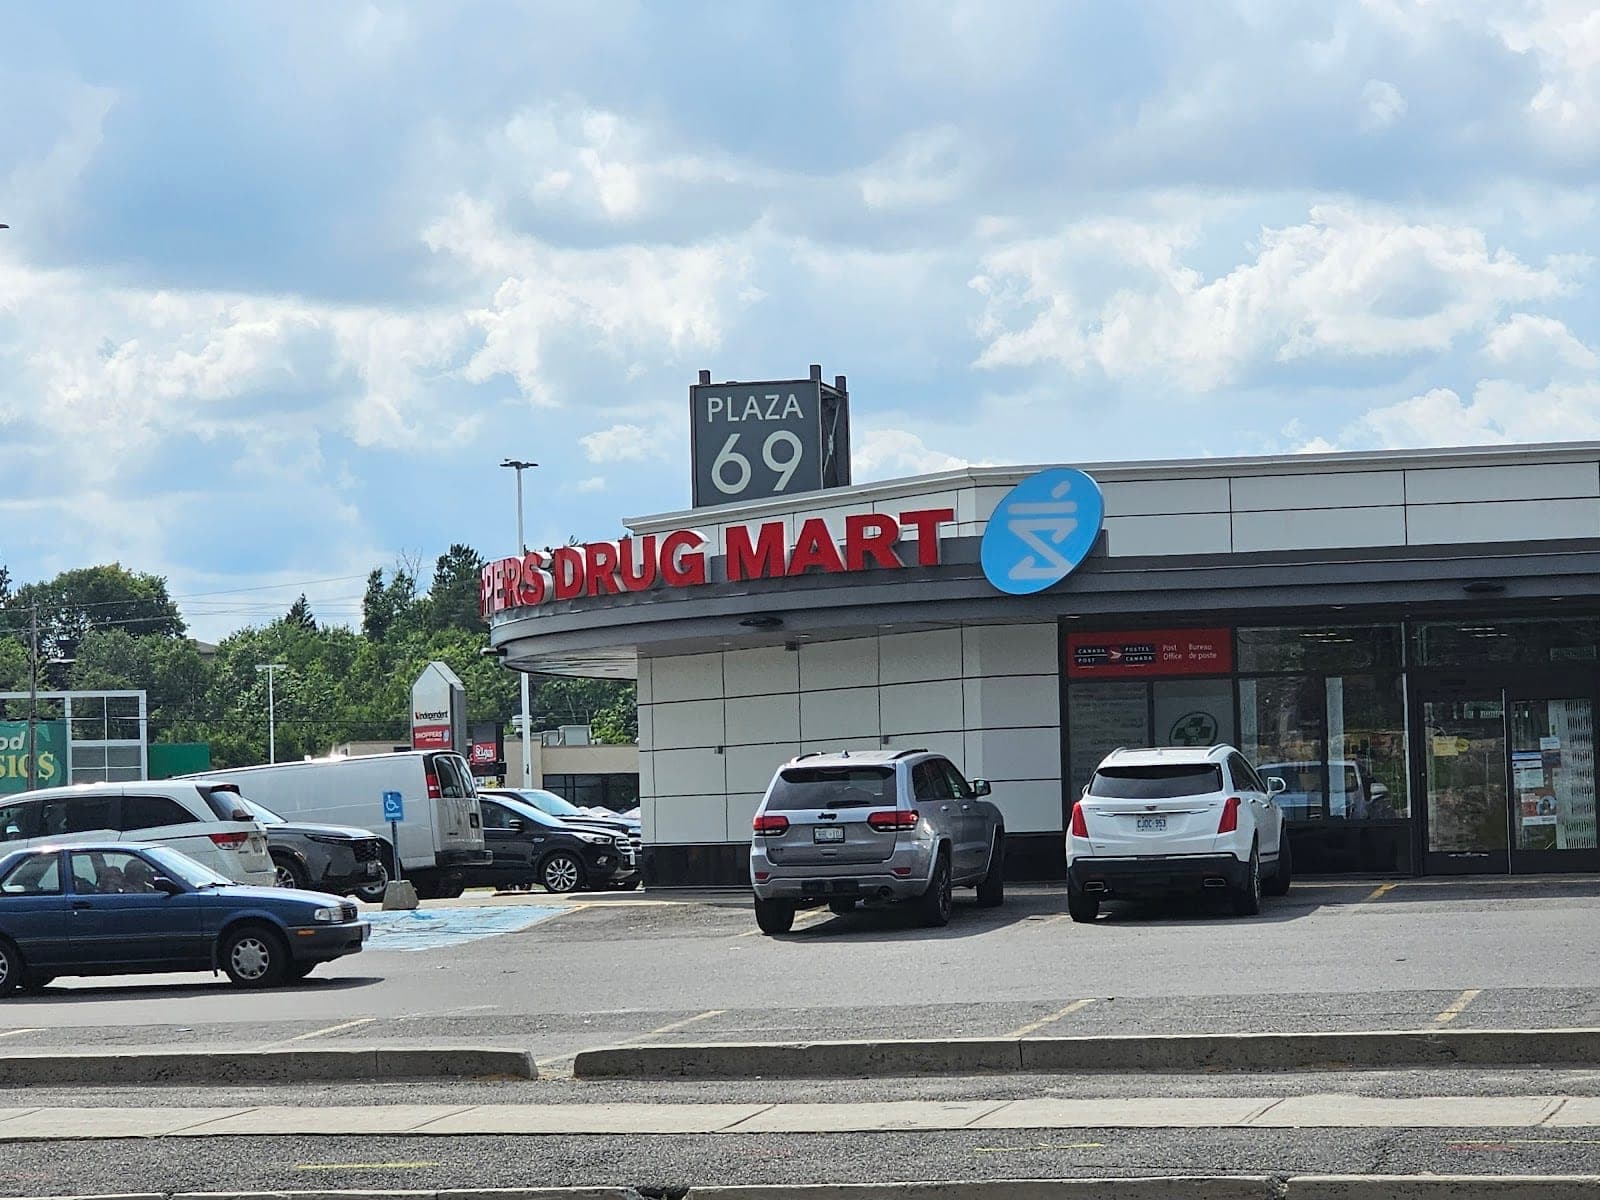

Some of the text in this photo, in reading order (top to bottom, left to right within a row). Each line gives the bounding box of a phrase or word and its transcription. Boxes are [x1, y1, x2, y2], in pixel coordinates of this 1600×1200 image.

[707, 393, 804, 423] PLAZA
[711, 430, 803, 495] 69
[554, 528, 706, 600] DRUG
[725, 508, 954, 582] MART
[1162, 644, 1177, 652] Post
[1188, 643, 1212, 651] Bureau
[1163, 653, 1182, 661] Office
[1198, 652, 1217, 661] poste
